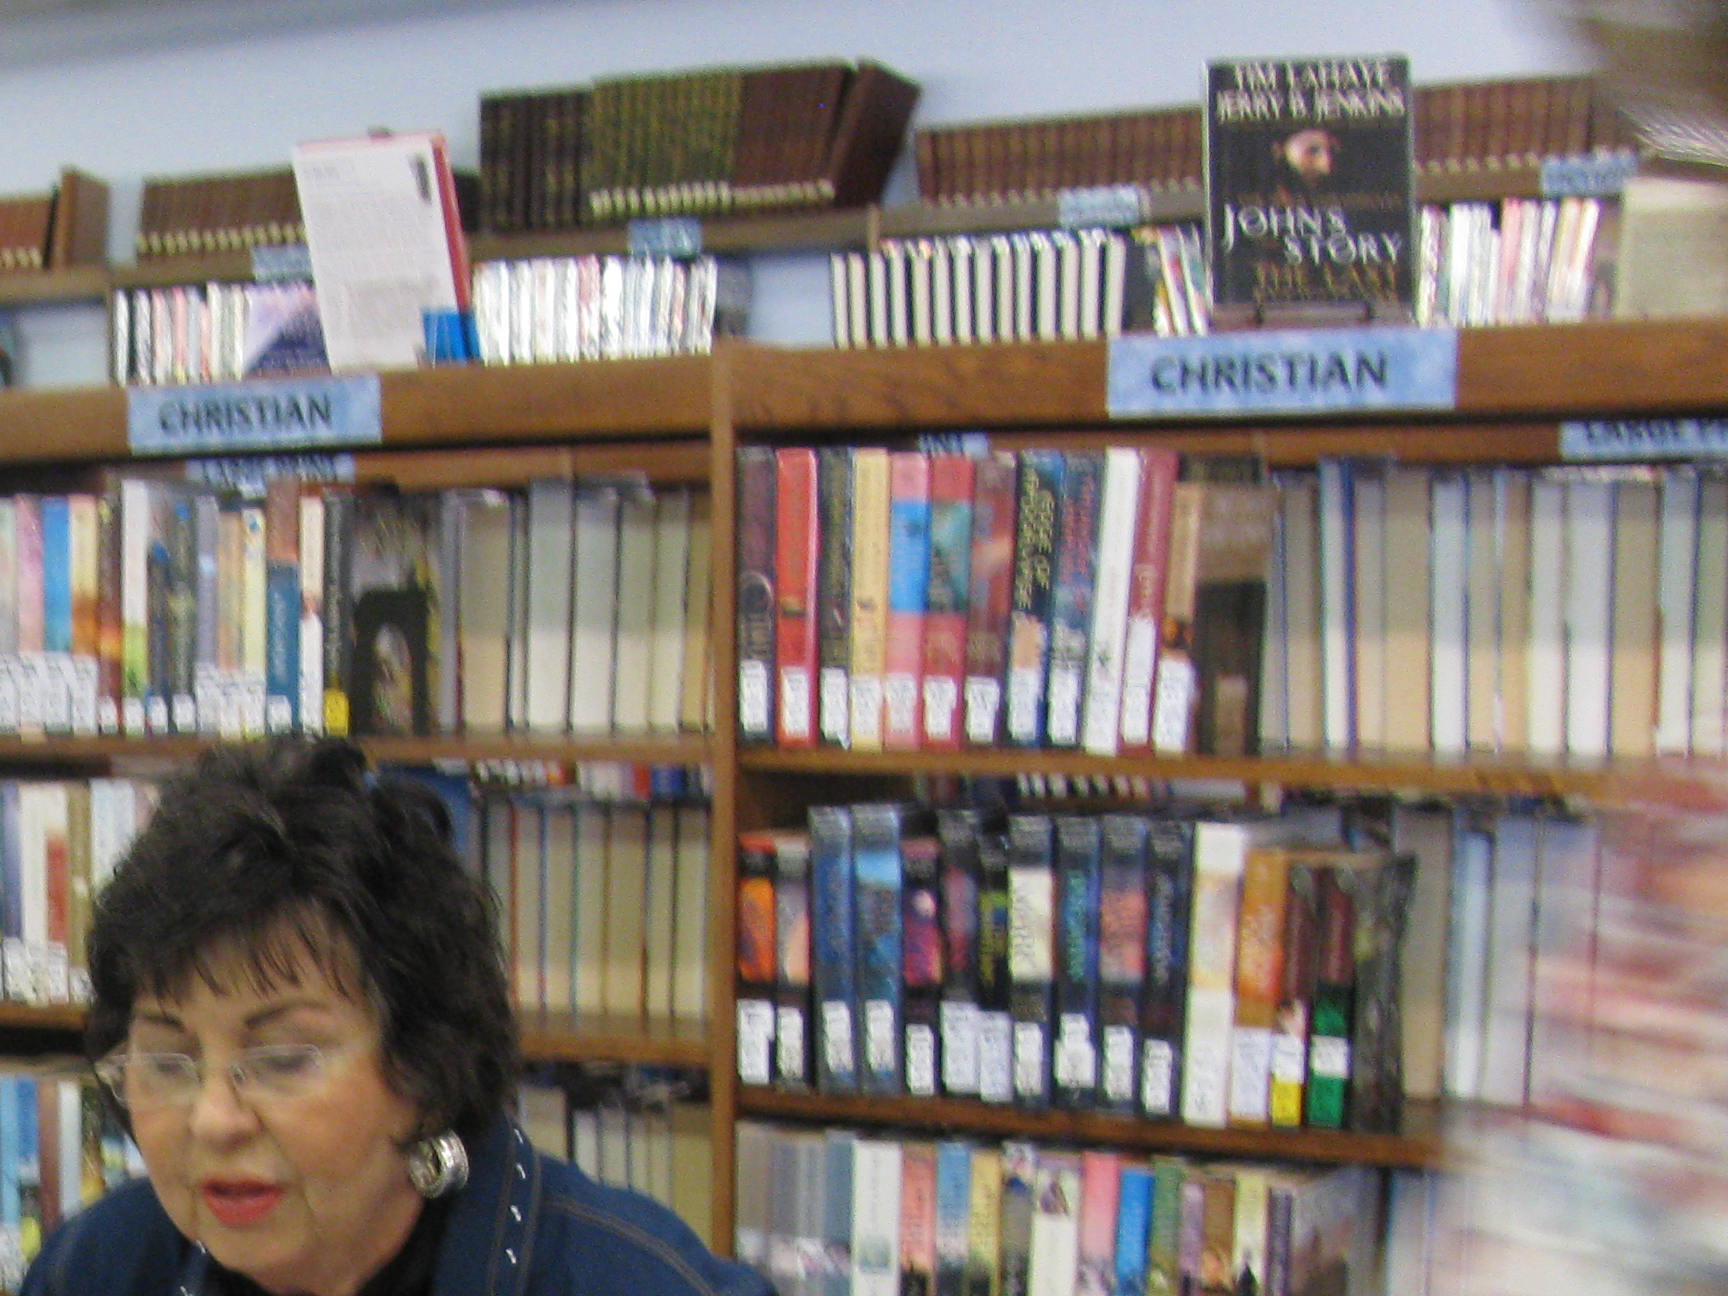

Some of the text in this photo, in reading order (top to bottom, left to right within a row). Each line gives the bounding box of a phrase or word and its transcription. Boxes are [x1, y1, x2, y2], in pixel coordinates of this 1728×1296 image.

[1284, 232, 1402, 266] STORY
[1151, 350, 1389, 393] CHRISTIAN
[159, 394, 332, 434] CHRISTIAN
